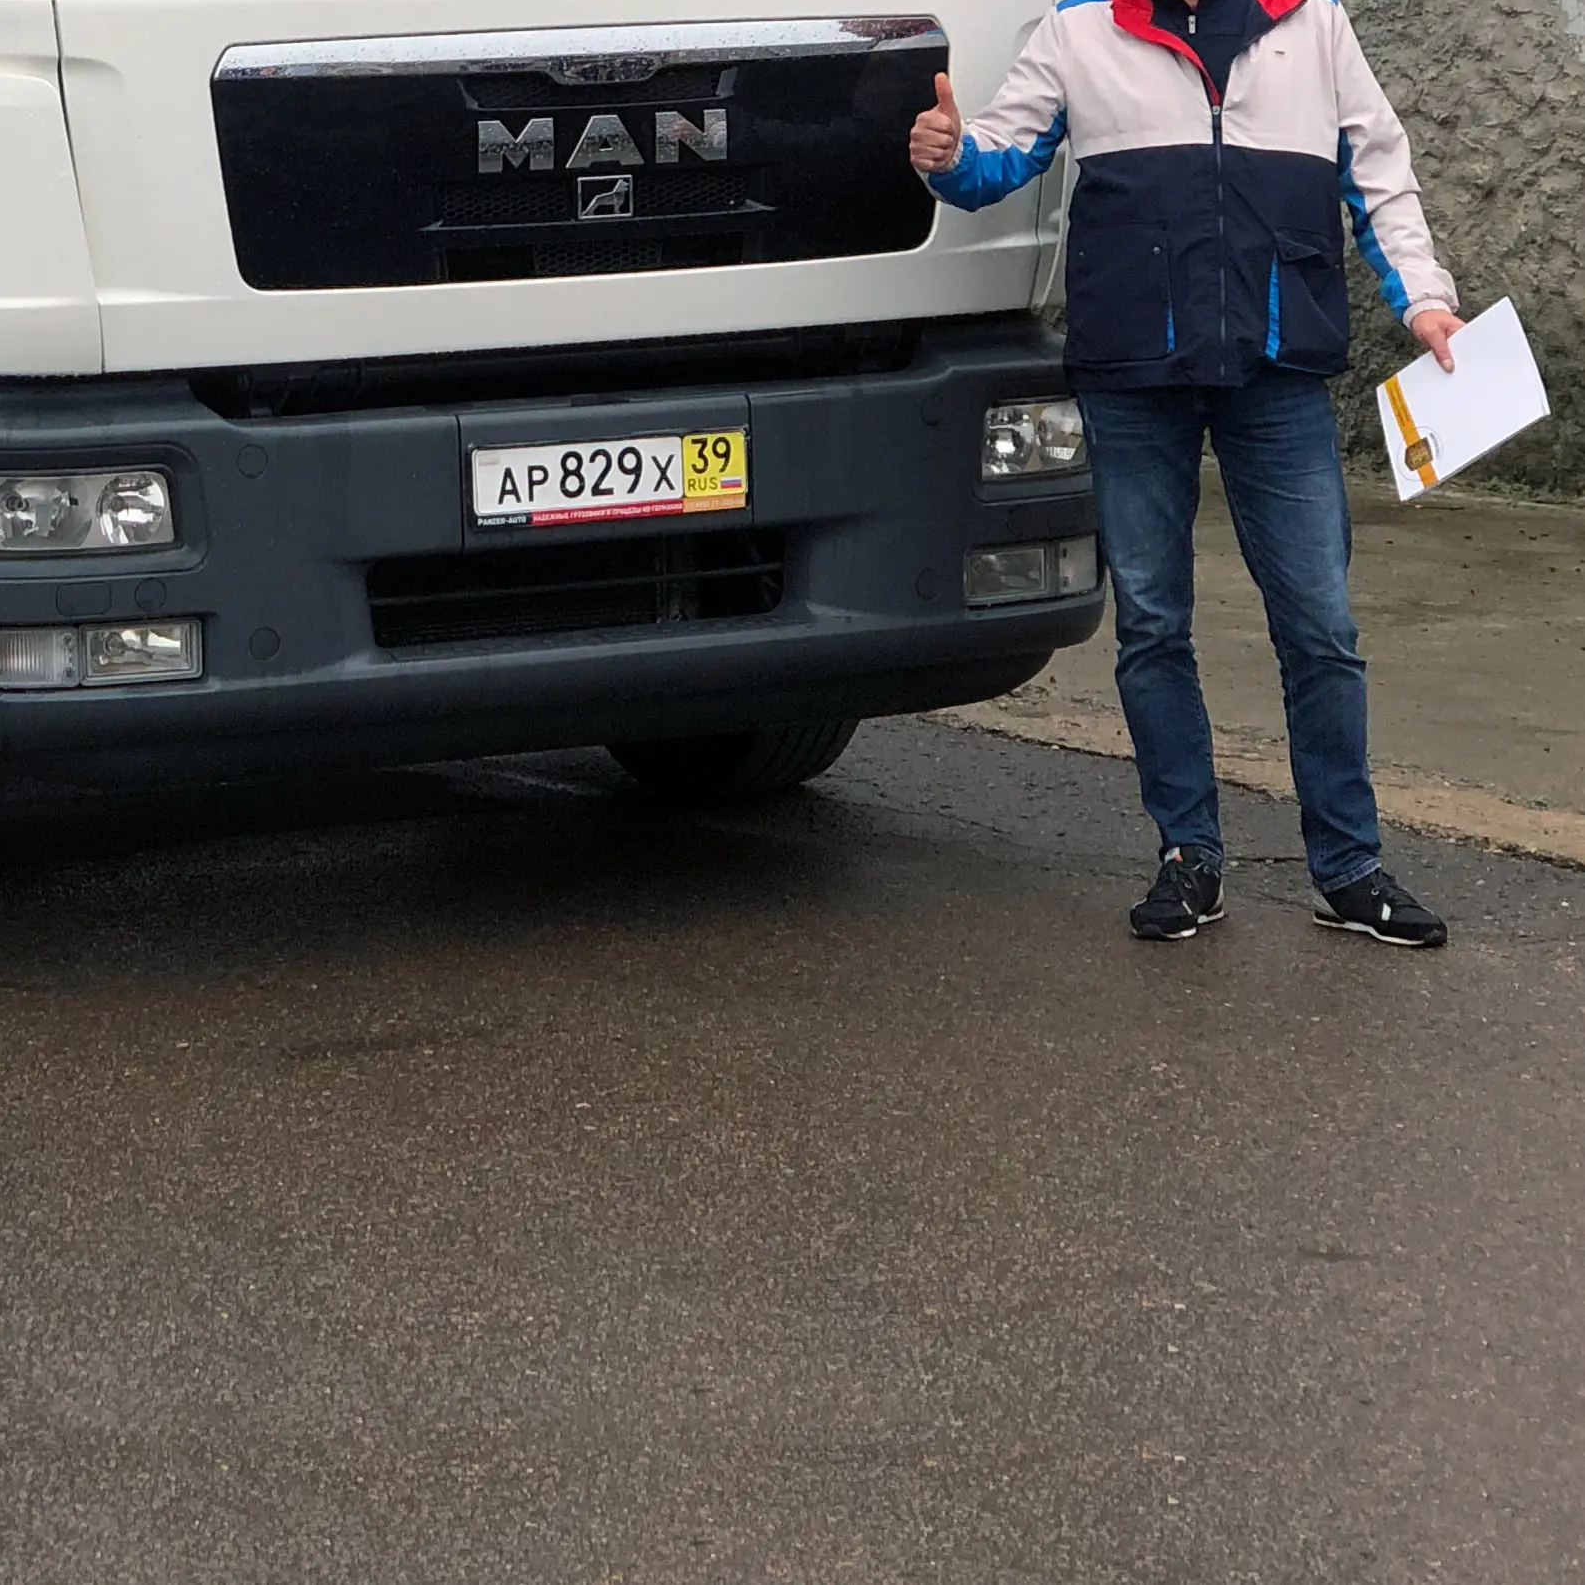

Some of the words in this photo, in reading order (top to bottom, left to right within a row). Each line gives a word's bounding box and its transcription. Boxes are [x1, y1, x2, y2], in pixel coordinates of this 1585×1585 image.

[478, 109, 727, 173] MAN
[691, 437, 731, 474] 39
[688, 476, 718, 491] RUS
